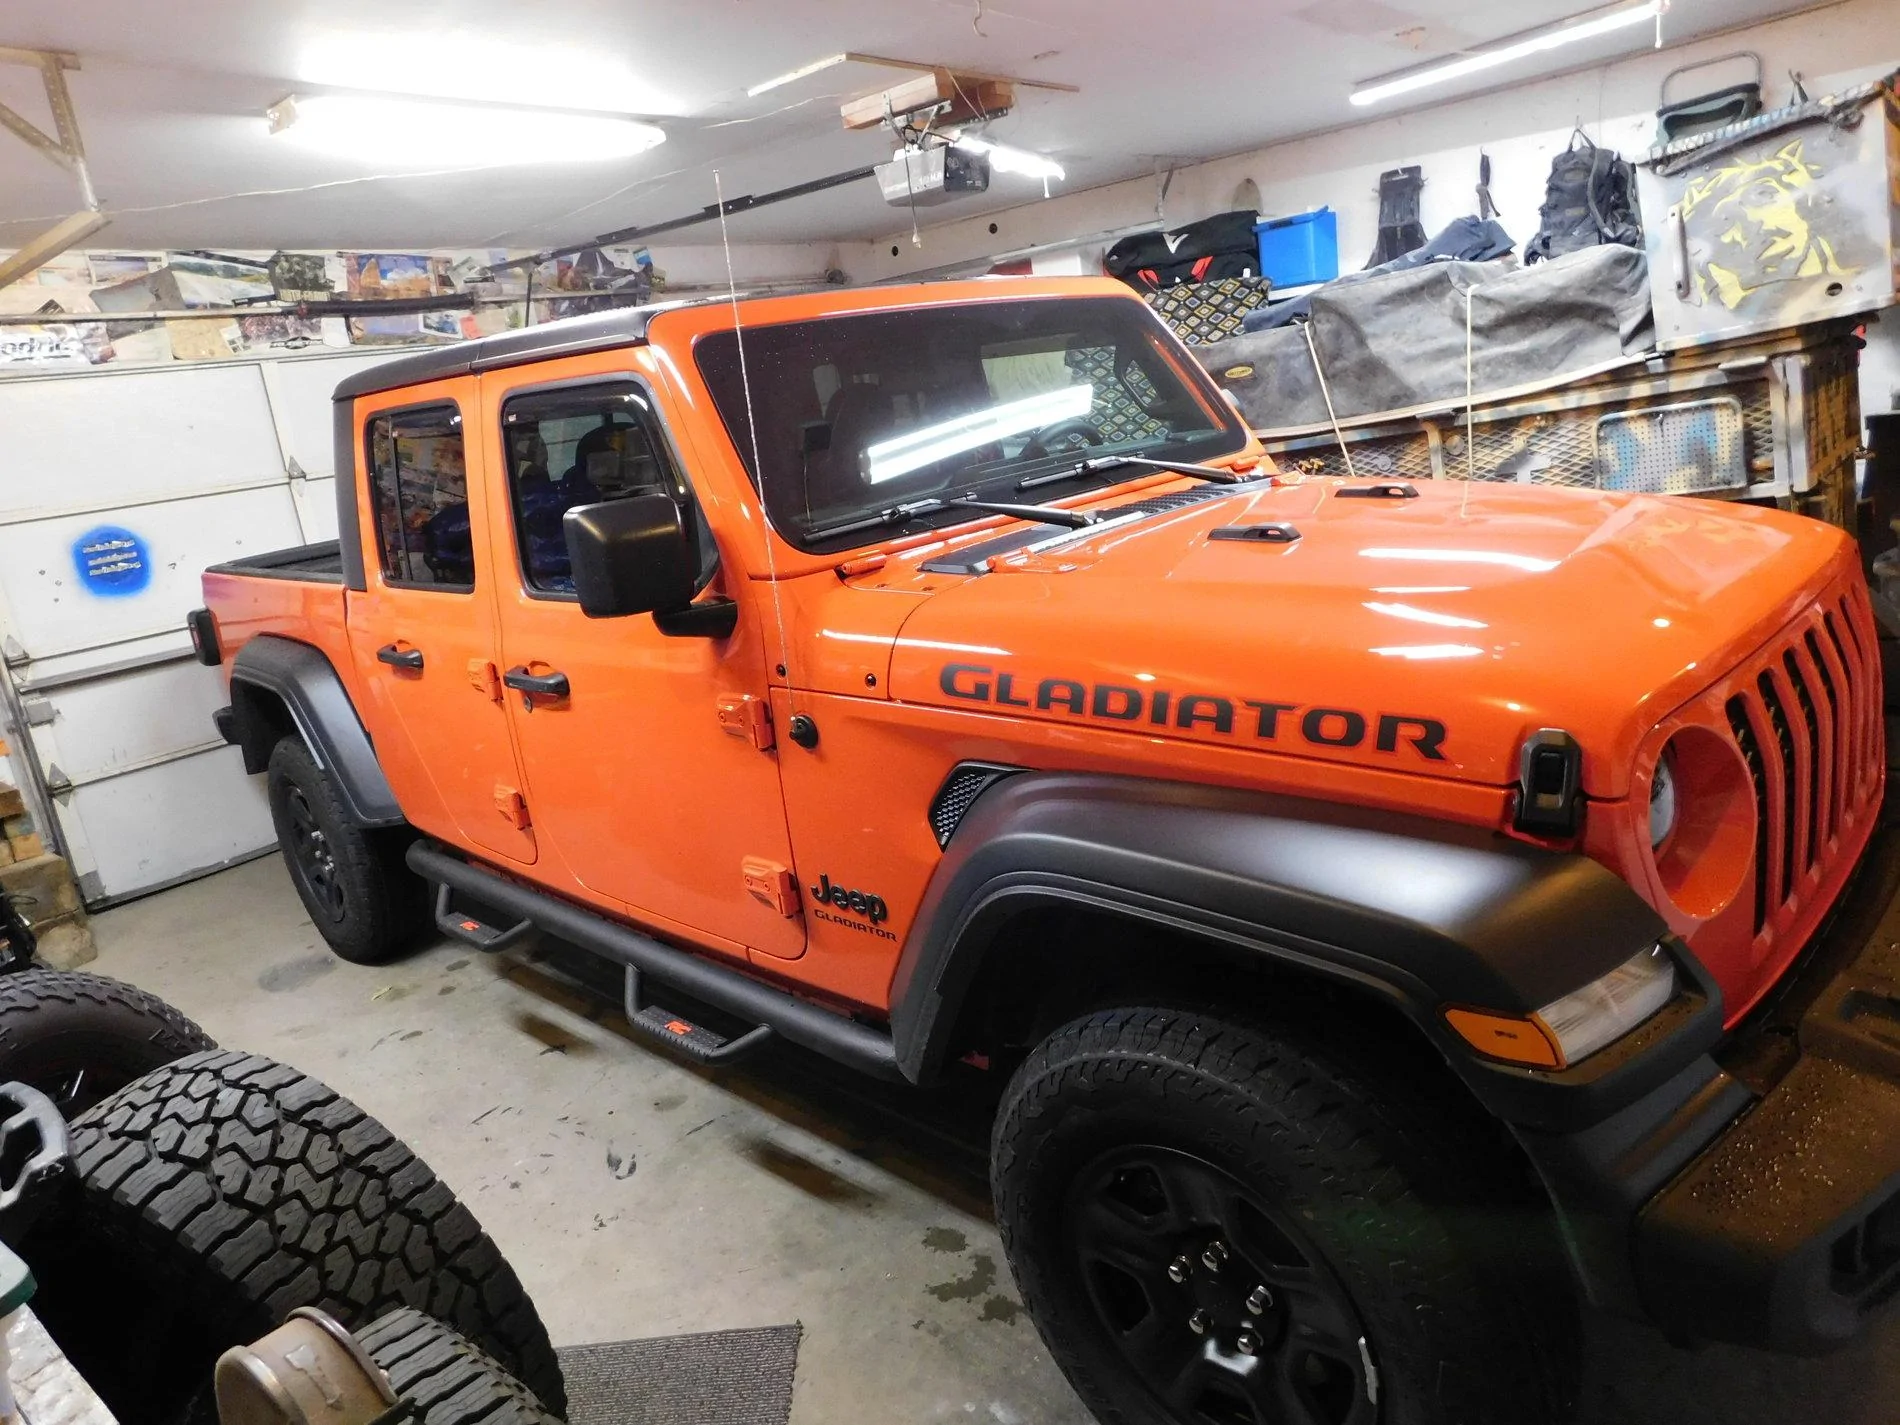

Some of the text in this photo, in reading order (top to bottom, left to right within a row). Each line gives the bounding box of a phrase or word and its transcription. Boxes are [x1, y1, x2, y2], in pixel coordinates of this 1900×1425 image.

[940, 663, 1446, 760] GLADIATOR
[810, 872, 887, 925] Jeep
[814, 908, 897, 942] GLADIATOR
